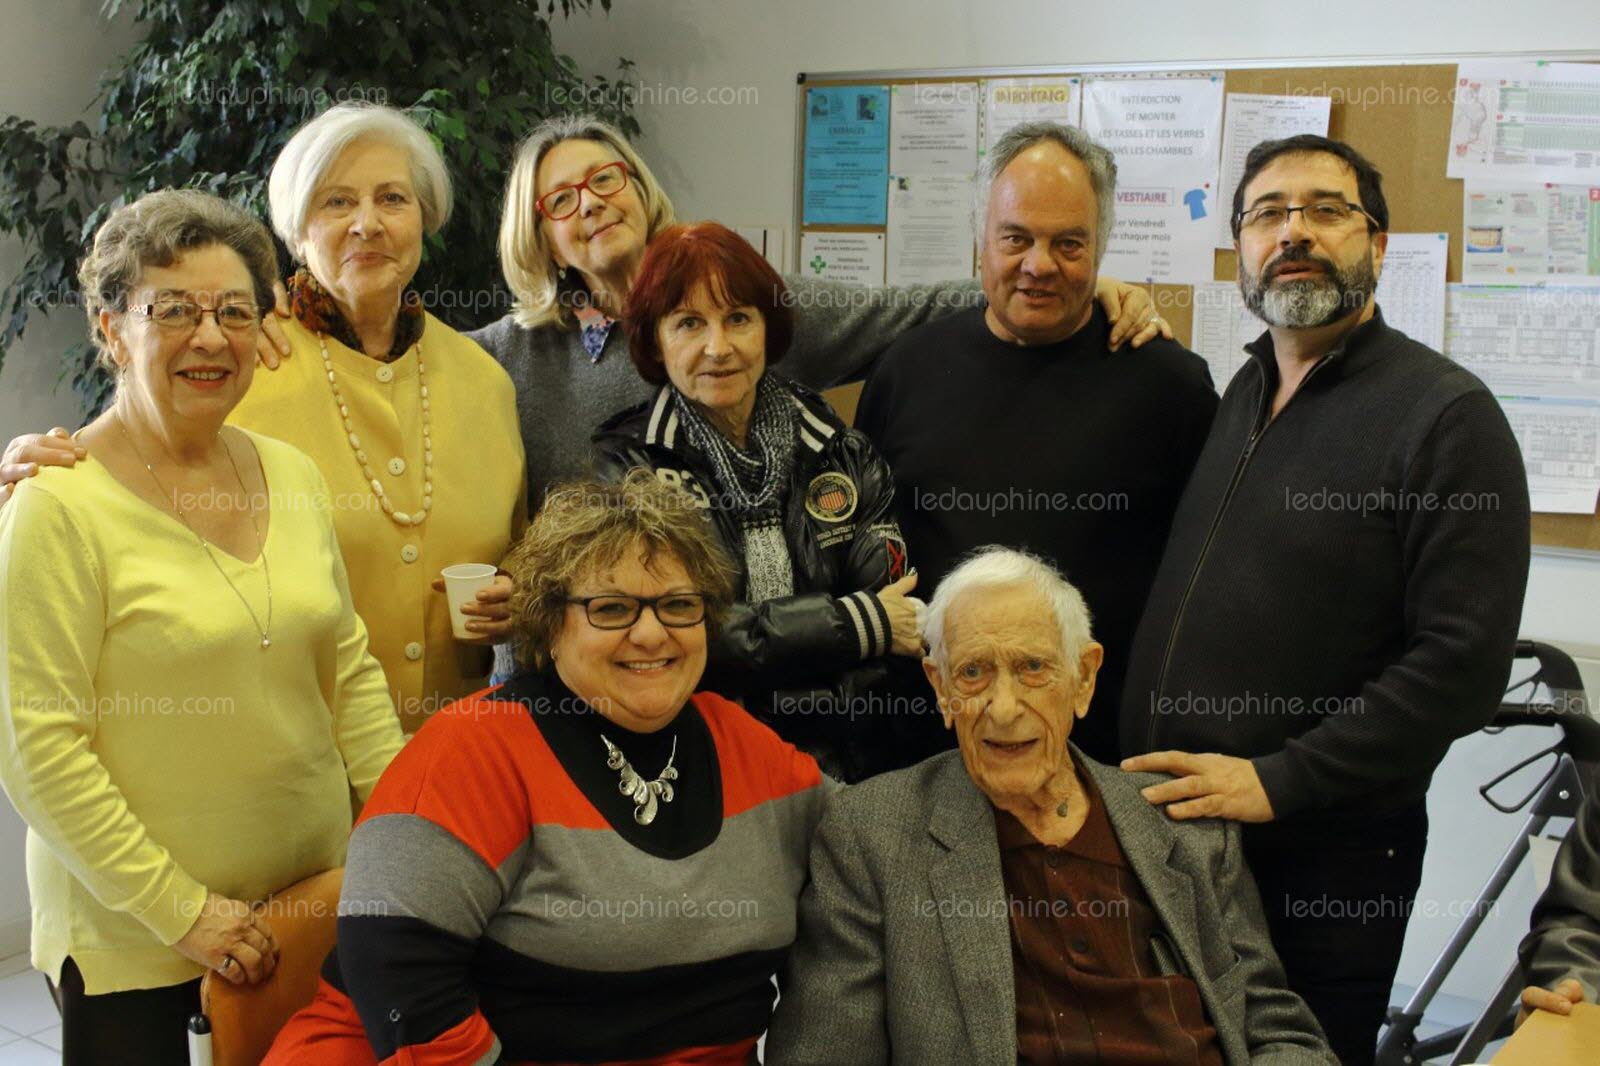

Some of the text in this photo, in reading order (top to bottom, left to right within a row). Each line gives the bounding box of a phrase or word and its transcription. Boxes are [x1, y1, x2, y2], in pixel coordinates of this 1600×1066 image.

[1121, 96, 1181, 105] INTERDICTION
[1126, 112, 1177, 121] DE MONTER
[1115, 129, 1143, 138] TASSES
[1145, 129, 1155, 138] ET
[1157, 129, 1171, 138] LES
[1173, 129, 1205, 138] VERRES
[1131, 146, 1144, 155] LES
[1145, 146, 1194, 155] CHAMBRES
[1117, 192, 1167, 203] VESTIAIRE
[1128, 219, 1167, 228] Vendredi
[1120, 232, 1150, 242] chaque
[1151, 232, 1171, 241] mois
